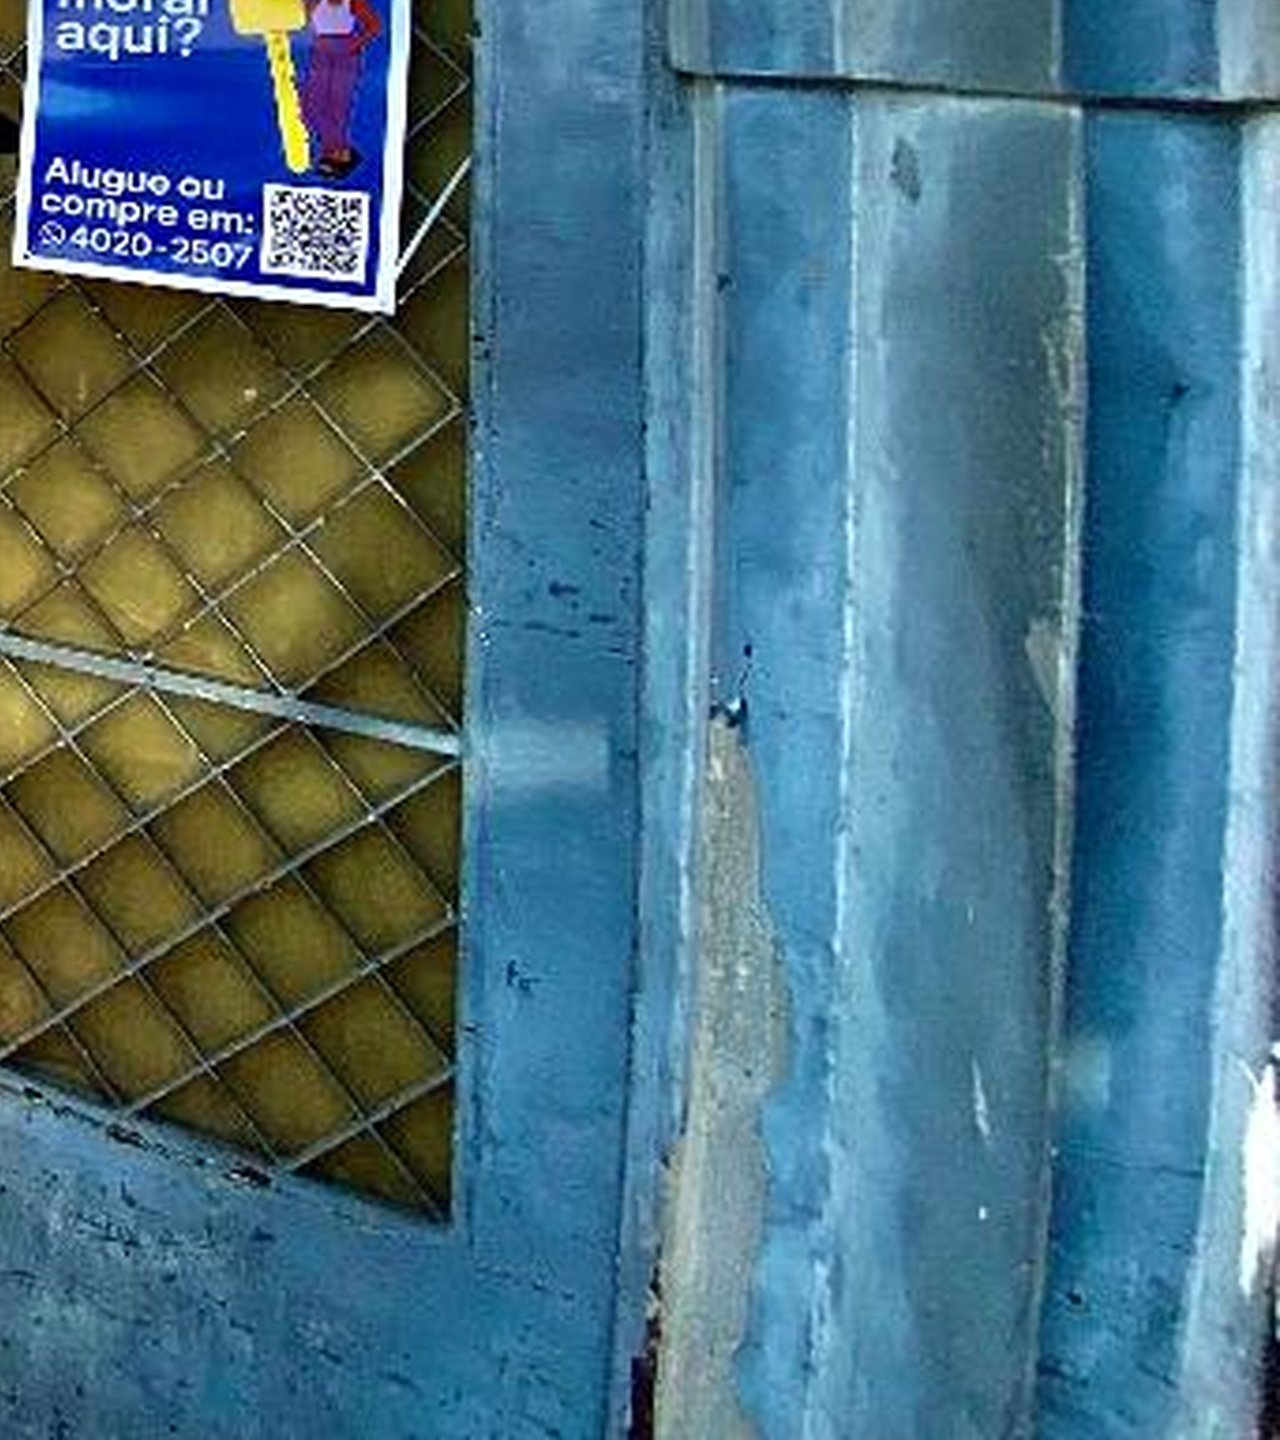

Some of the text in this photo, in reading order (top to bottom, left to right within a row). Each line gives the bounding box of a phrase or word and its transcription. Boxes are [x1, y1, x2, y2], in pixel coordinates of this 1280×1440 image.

[56, 15, 204, 61] aqui?
[44, 157, 225, 200] Alugue ou
[41, 193, 254, 235] compre em:
[70, 225, 254, 270] 4020-2507
